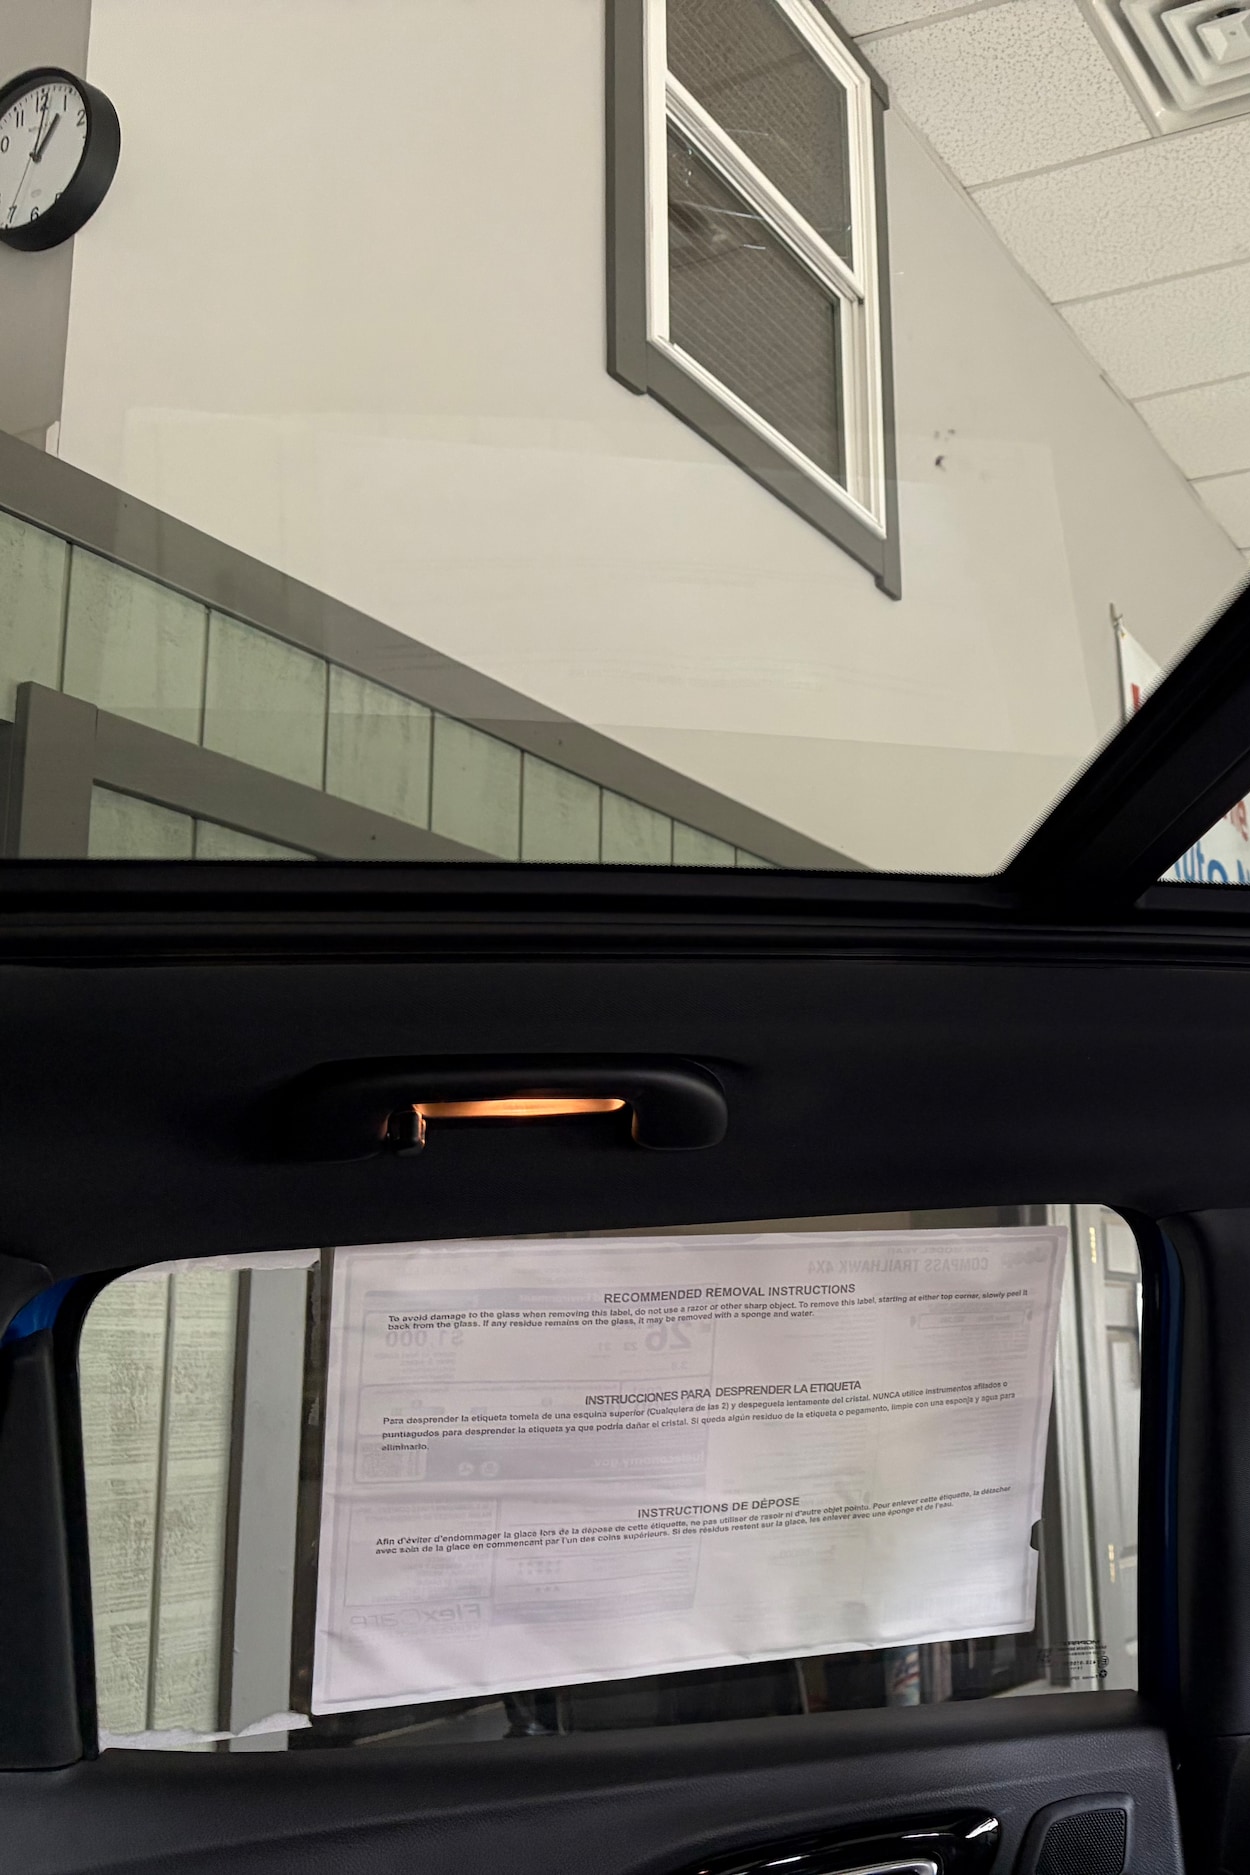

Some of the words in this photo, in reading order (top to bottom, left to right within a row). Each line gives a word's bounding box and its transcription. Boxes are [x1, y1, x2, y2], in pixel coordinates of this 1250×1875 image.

[76, 109, 86, 127] 2
[0, 136, 10, 153] 0
[30, 206, 39, 222] 6
[402, 1313, 427, 1321] avoid
[430, 1313, 466, 1321] damage
[496, 1310, 520, 1319] glass
[548, 1309, 589, 1318] removing
[610, 1308, 632, 1316] label,
[648, 1306, 661, 1314] not
[744, 1301, 767, 1310] sharp
[769, 1301, 796, 1310] object.
[857, 1296, 876, 1305] label,
[878, 1294, 907, 1303] starting
[941, 1292, 953, 1301] top
[982, 1290, 1005, 1299] slowly
[1006, 1289, 1021, 1298] peel
[604, 1289, 701, 1303] RECOMMENDED
[705, 1285, 765, 1297] REMOVAL
[768, 1284, 855, 1296] INSTRUCTIONS
[387, 1322, 410, 1330] back
[453, 1320, 480, 1329] glass.
[544, 1318, 579, 1326] remains
[610, 1317, 635, 1326] glass,
[677, 1312, 712, 1320] removed
[714, 1310, 731, 1318] with
[740, 1311, 771, 1319] sponge
[773, 1309, 788, 1317] and
[406, 1415, 459, 1424] desprender
[471, 1413, 507, 1422] etiqueta
[573, 1410, 607, 1419] esquina
[609, 1408, 645, 1418] superior
[646, 1405, 694, 1416] (Cualquiera
[786, 1397, 830, 1406] lentamente
[872, 1391, 900, 1400] NUNCA
[925, 1384, 972, 1394] instrumentos
[585, 1390, 678, 1405] INSTRUCCIONES
[681, 1388, 710, 1399] PARA
[715, 1383, 791, 1397] DESPRENDER
[793, 1384, 808, 1393] LA
[810, 1381, 861, 1392] ETIQUETA
[464, 1426, 516, 1436] desprender
[528, 1424, 563, 1434] etiqueta
[700, 1415, 725, 1424] queda
[752, 1412, 782, 1420] residuo
[805, 1408, 836, 1418] etiqueta
[891, 1401, 913, 1410] limpie
[999, 1392, 1015, 1401] para
[433, 1533, 501, 1542] d'endommager
[513, 1530, 537, 1539] glace
[719, 1515, 747, 1523] utiliser
[760, 1511, 784, 1520] rasoir
[794, 1507, 821, 1516] d'autre
[823, 1504, 842, 1514] objet
[892, 1498, 918, 1507] enlever
[920, 1494, 937, 1503] cette
[637, 1502, 728, 1518] INSTRUCTIONS
[732, 1501, 748, 1511] DE
[751, 1496, 800, 1509] DÉPOSE
[421, 1544, 433, 1552] de
[446, 1543, 470, 1552] glace
[545, 1538, 559, 1546] par
[597, 1533, 620, 1541] coins
[731, 1521, 759, 1530] restent
[784, 1518, 807, 1527] glace,
[822, 1513, 850, 1521] enlever
